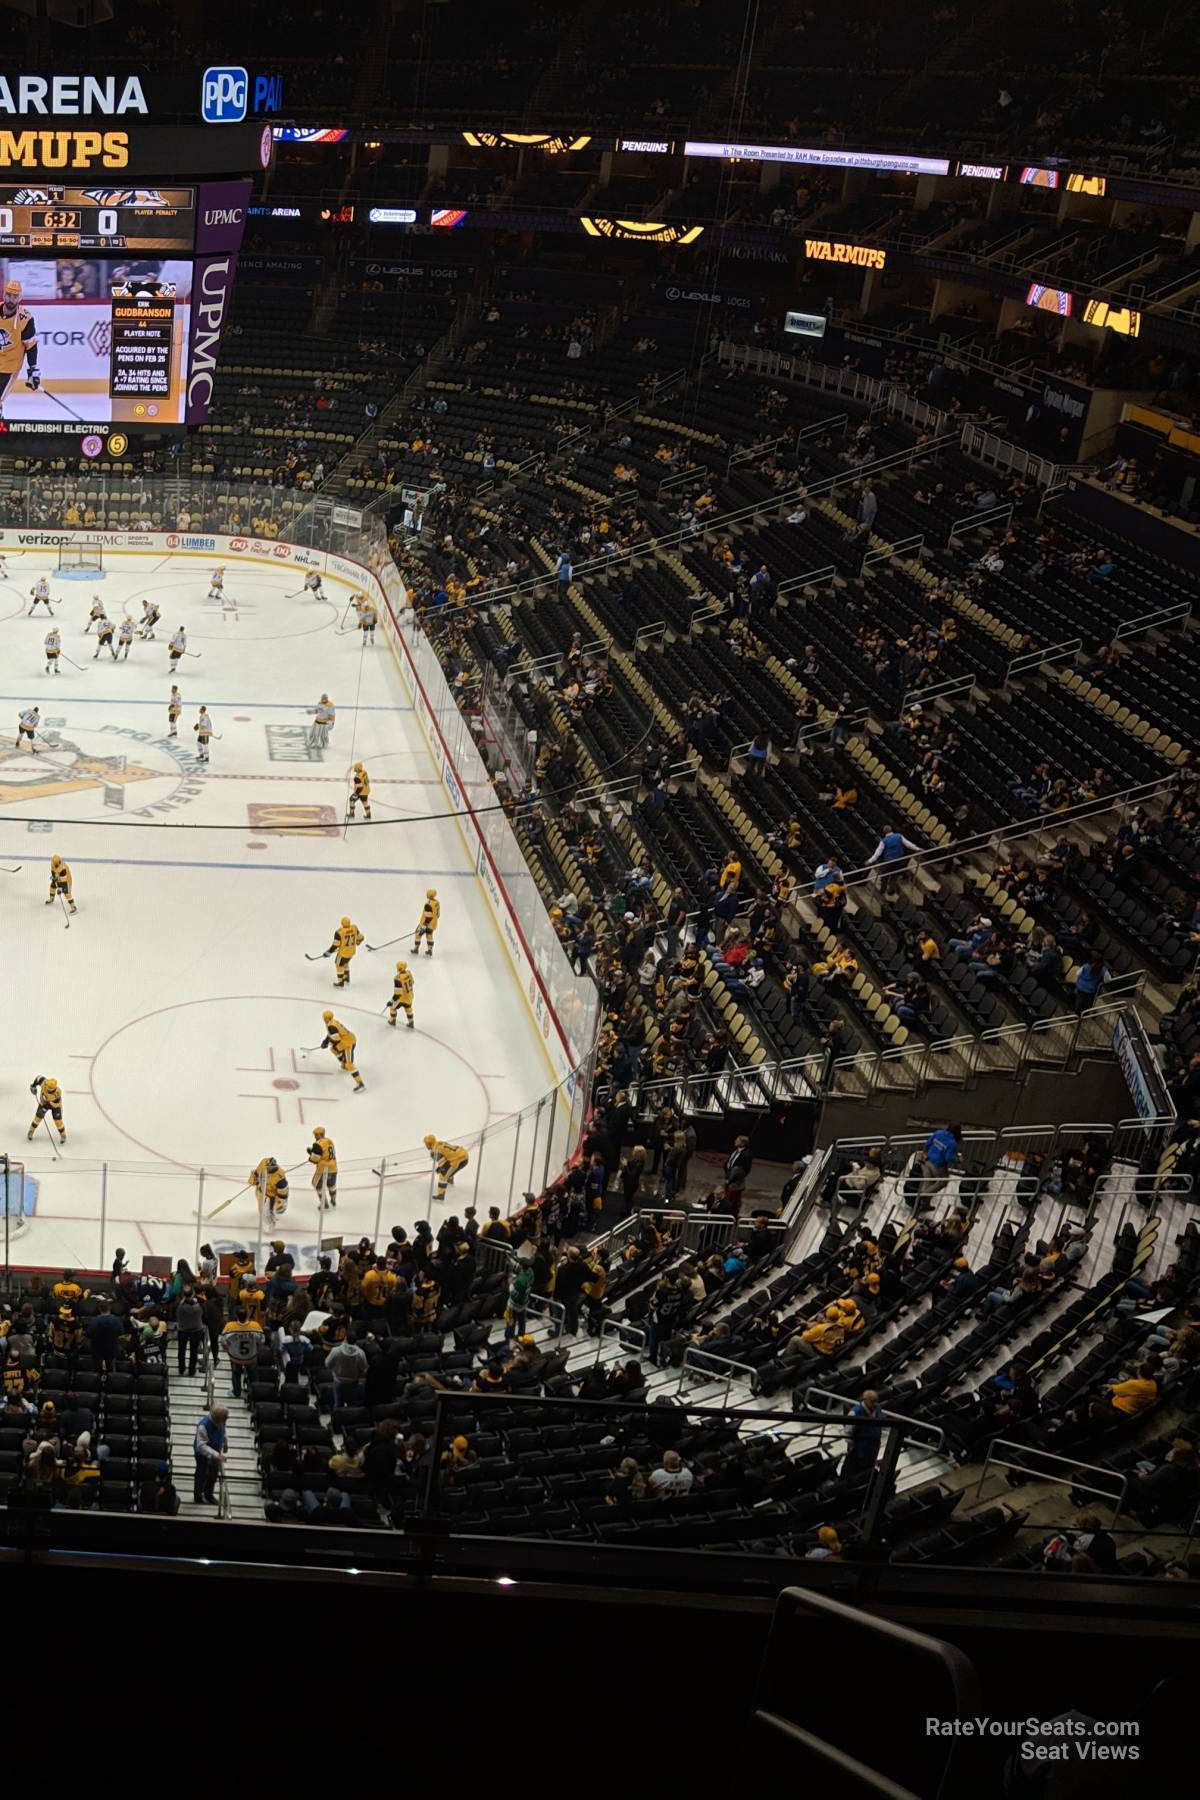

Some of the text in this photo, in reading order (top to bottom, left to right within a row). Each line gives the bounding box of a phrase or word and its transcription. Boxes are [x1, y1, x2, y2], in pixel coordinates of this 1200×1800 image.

[205, 74, 245, 116] PPG
[622, 141, 668, 152] PENGUINS
[961, 163, 1003, 179] PENGUINS
[205, 208, 242, 225] UPMC
[272, 208, 300, 216] ARENA
[44, 212, 76, 227] 6:32
[98, 210, 117, 235] 0
[805, 239, 886, 269] WARMUPS
[431, 268, 458, 278] LOGES
[115, 308, 171, 317] GUDBRANSON
[188, 258, 230, 408] UPMC
[115, 346, 146, 354] ACQUIRED
[9, 423, 109, 434] MITSUBISHI ELECTRIC
[18, 533, 69, 546] verizon
[86, 535, 124, 545] UPMC
[181, 537, 215, 548] LUMBER
[99, 725, 152, 740] PPG
[131, 779, 207, 818] ARENA
